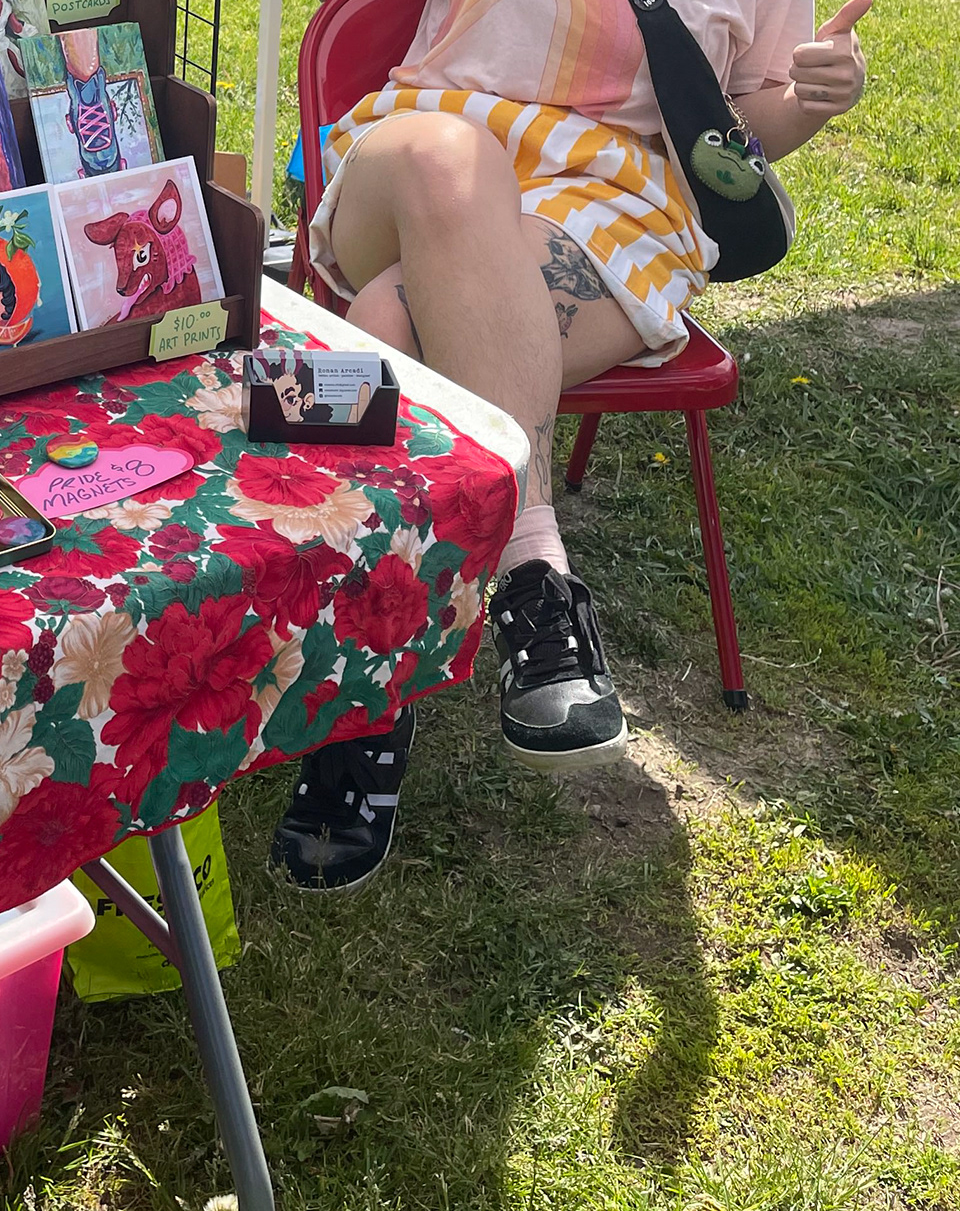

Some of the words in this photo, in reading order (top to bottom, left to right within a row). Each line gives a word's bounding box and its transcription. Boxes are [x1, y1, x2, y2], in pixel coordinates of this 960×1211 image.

[159, 336, 178, 353] ART
[184, 326, 221, 347] PRINTS
[49, 472, 111, 493] PRIDE
[111, 459, 155, 476] $8
[43, 477, 137, 511] MAGNETS
